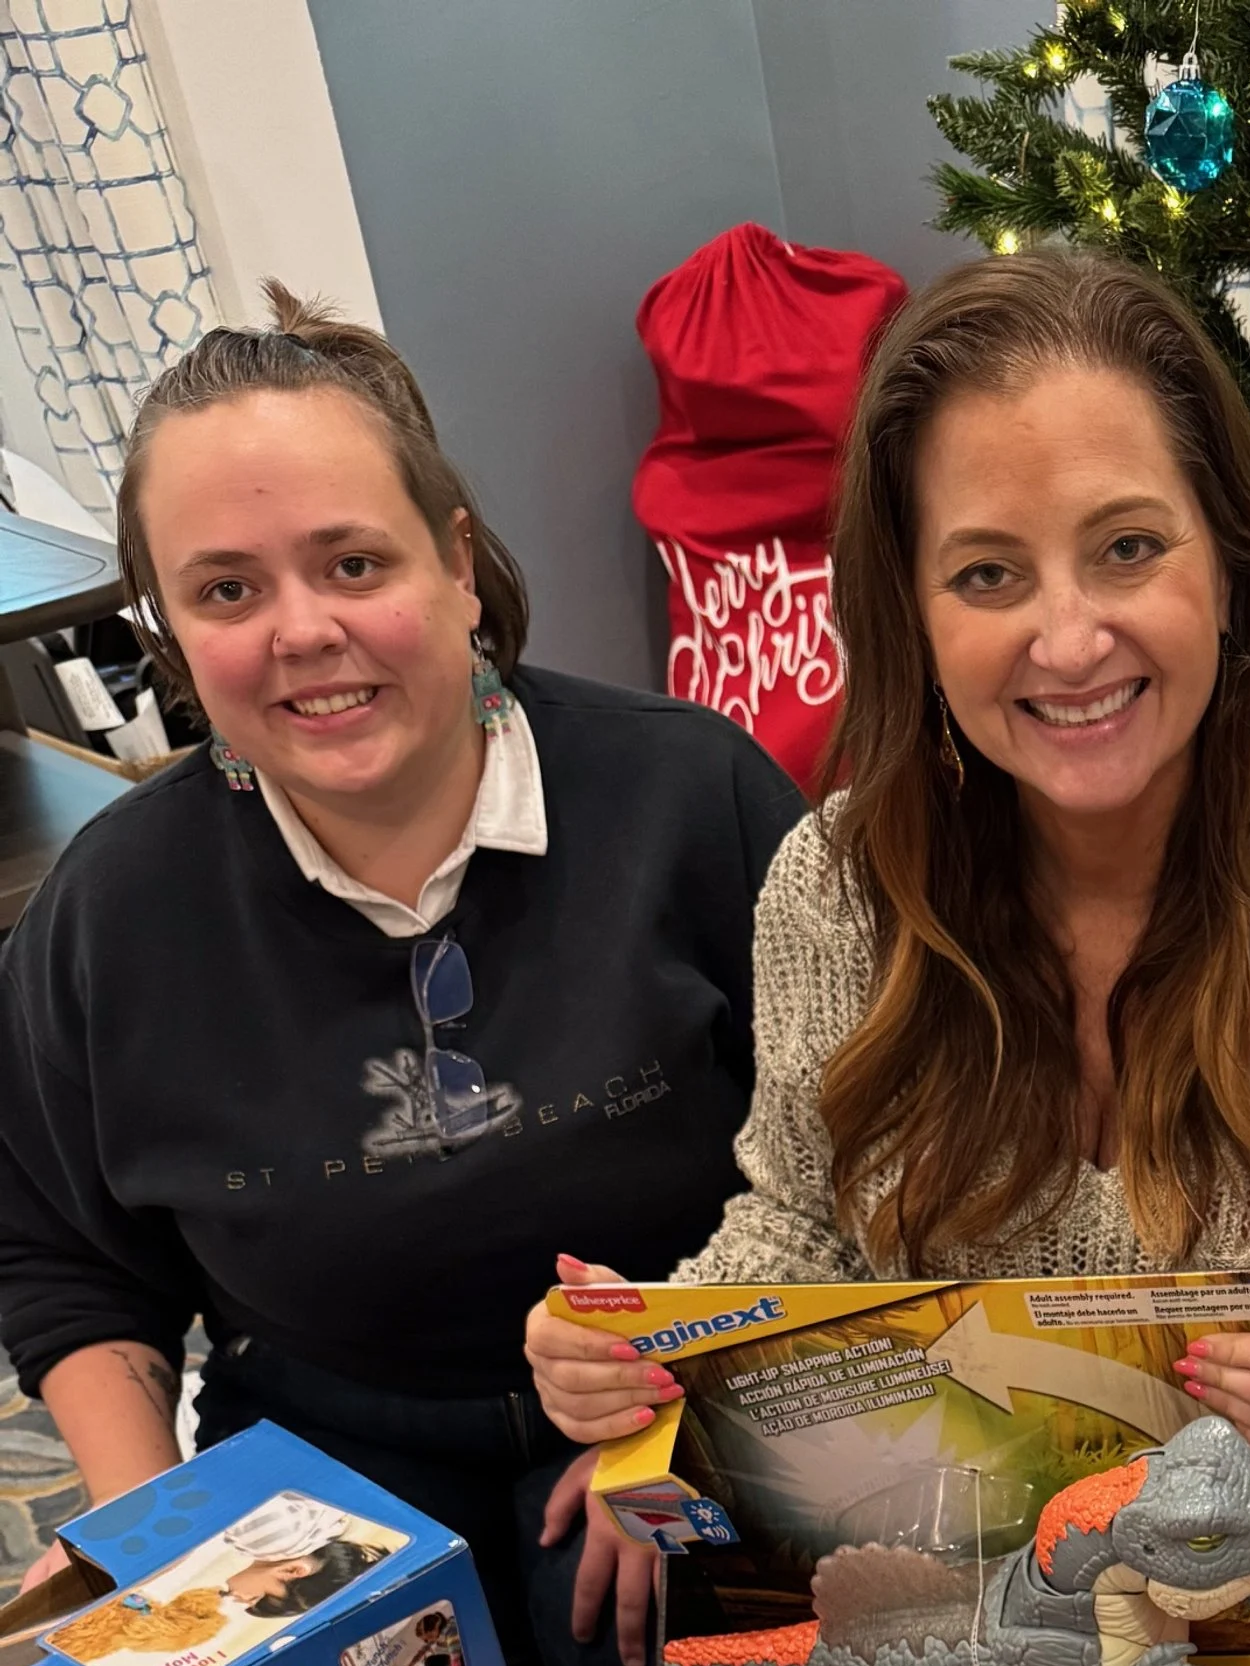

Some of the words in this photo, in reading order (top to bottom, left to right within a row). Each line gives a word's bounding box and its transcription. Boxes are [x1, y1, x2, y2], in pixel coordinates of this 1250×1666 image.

[604, 1081, 672, 1120] FLORIDA
[725, 1364, 780, 1391] LIGHT-UP
[781, 1349, 842, 1377] SNAPPING
[843, 1337, 893, 1361] ACTION!
[738, 1383, 783, 1407] ACCIÓN
[784, 1374, 828, 1398] RÁPIDA
[829, 1368, 846, 1384] DE
[846, 1347, 925, 1379] ILUMINACIÓN
[804, 1391, 822, 1408] DE
[822, 1377, 879, 1405] MORSURE
[879, 1359, 952, 1392] LUMINEUSE!
[796, 1411, 812, 1428] DE
[813, 1399, 865, 1425] MORDIDA
[865, 1383, 934, 1413] ILUMINADA!
